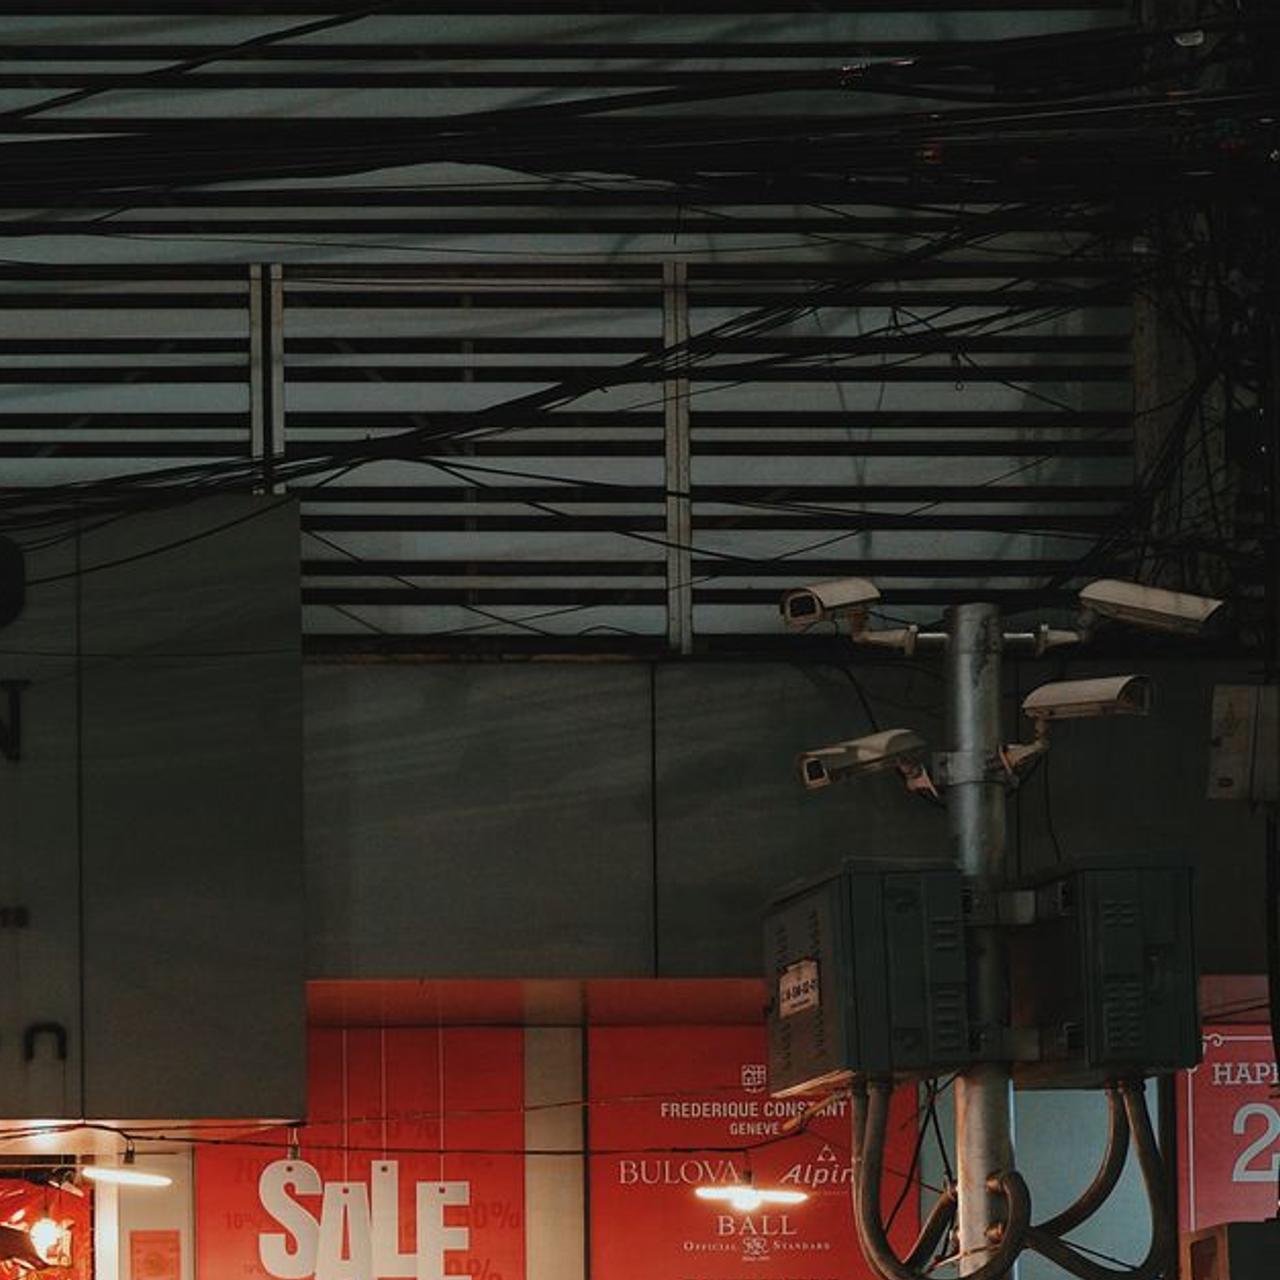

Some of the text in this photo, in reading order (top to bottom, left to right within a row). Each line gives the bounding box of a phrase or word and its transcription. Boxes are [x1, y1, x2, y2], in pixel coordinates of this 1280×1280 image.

[661, 1101, 760, 1119] FREDERIQUE
[619, 1159, 741, 1186] BULOVA
[716, 1214, 798, 1237] BALL
